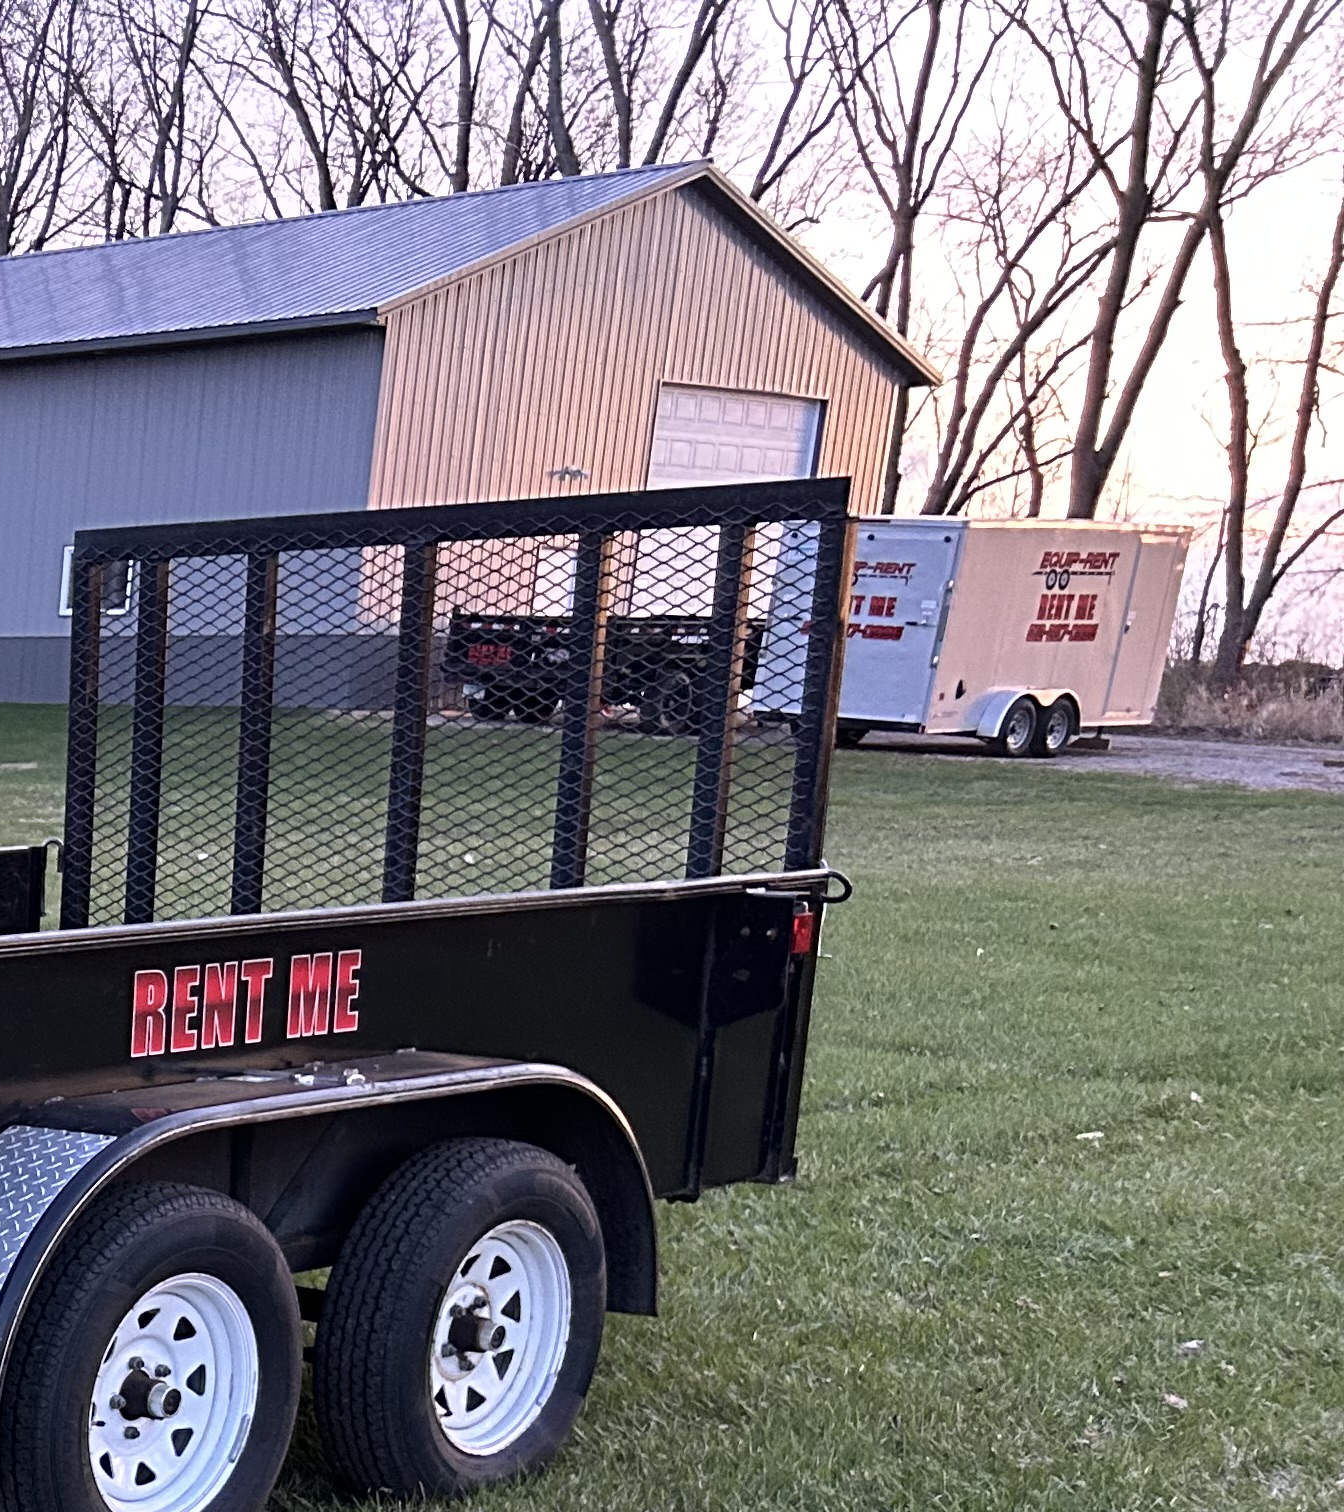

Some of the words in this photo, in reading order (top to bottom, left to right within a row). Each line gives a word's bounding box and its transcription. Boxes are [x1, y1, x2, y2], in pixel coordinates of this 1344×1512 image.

[1039, 551, 1121, 570] EQUIP-RENT
[130, 957, 274, 1058] RENT
[286, 949, 362, 1039] ME
